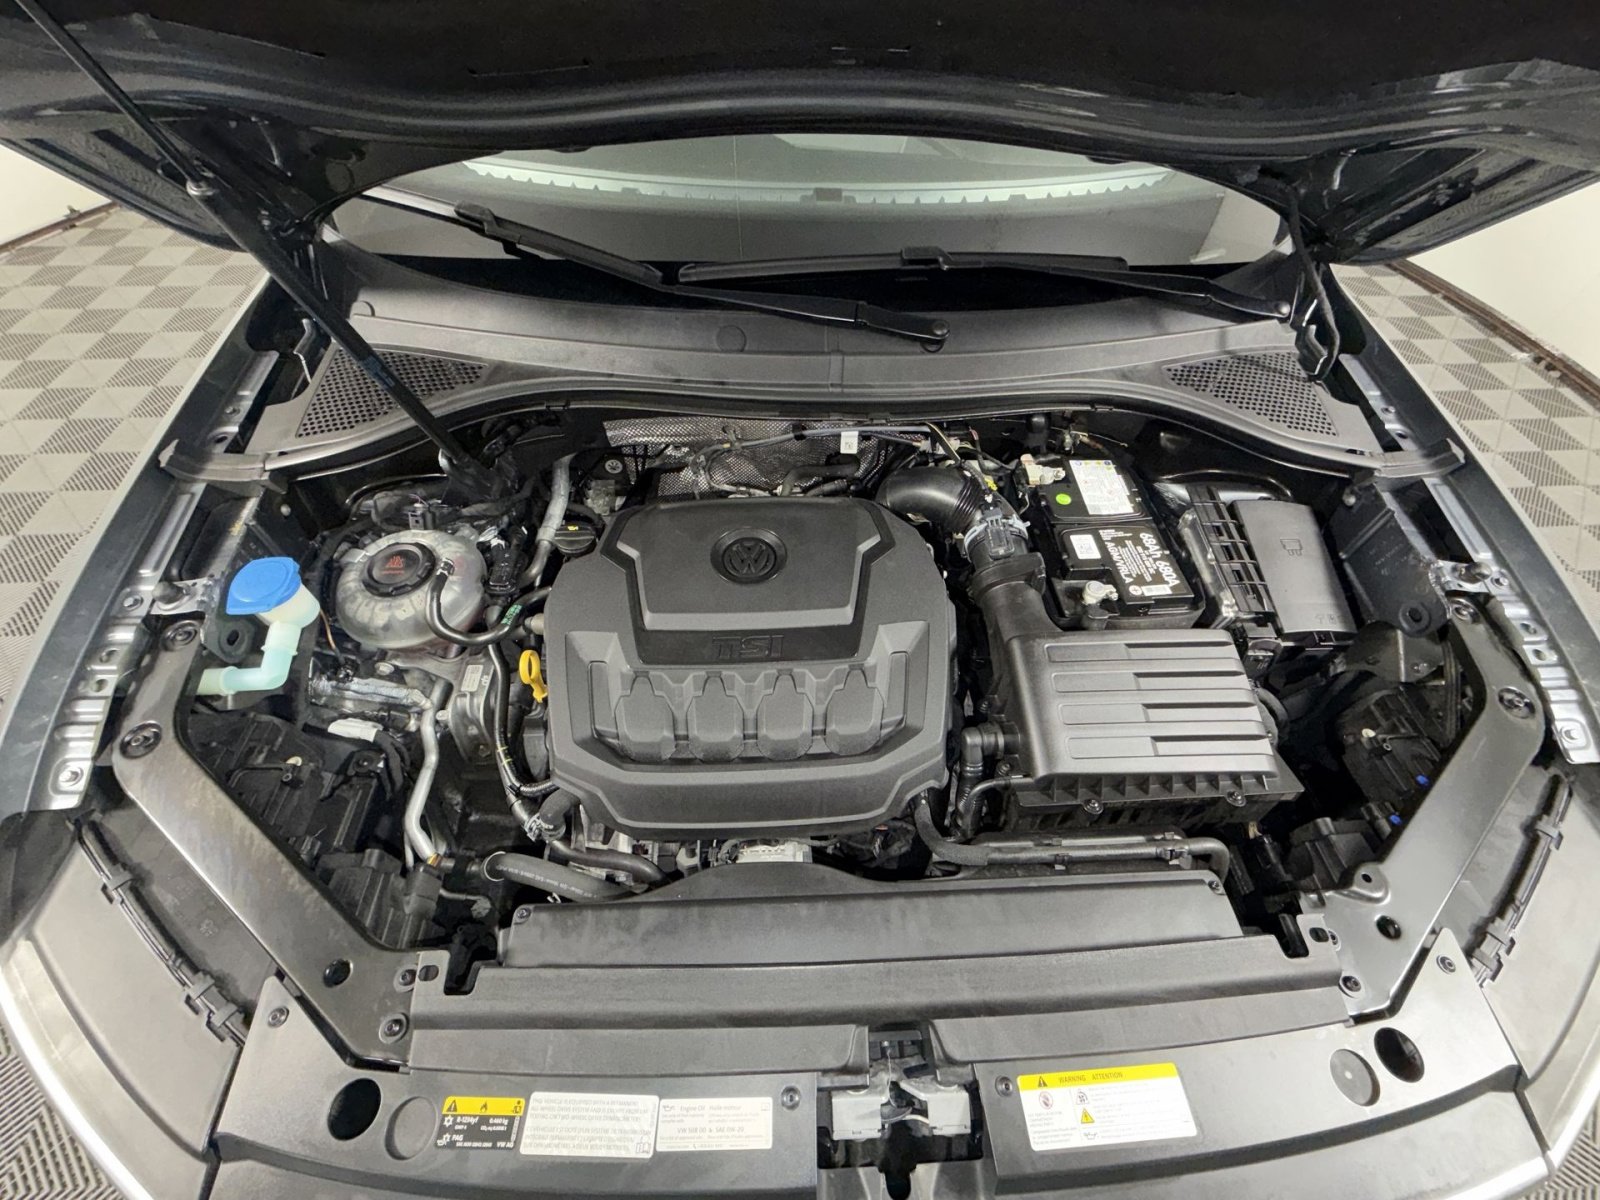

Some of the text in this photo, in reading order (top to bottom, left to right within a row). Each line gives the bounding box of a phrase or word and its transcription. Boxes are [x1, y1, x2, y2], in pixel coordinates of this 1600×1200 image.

[1105, 541, 1134, 584] AGM/VRLA
[1139, 532, 1163, 559] 68Ah
[1155, 560, 1181, 587] 680A
[712, 634, 784, 659] TSI
[1058, 1071, 1124, 1084] WARNING ATTENTION
